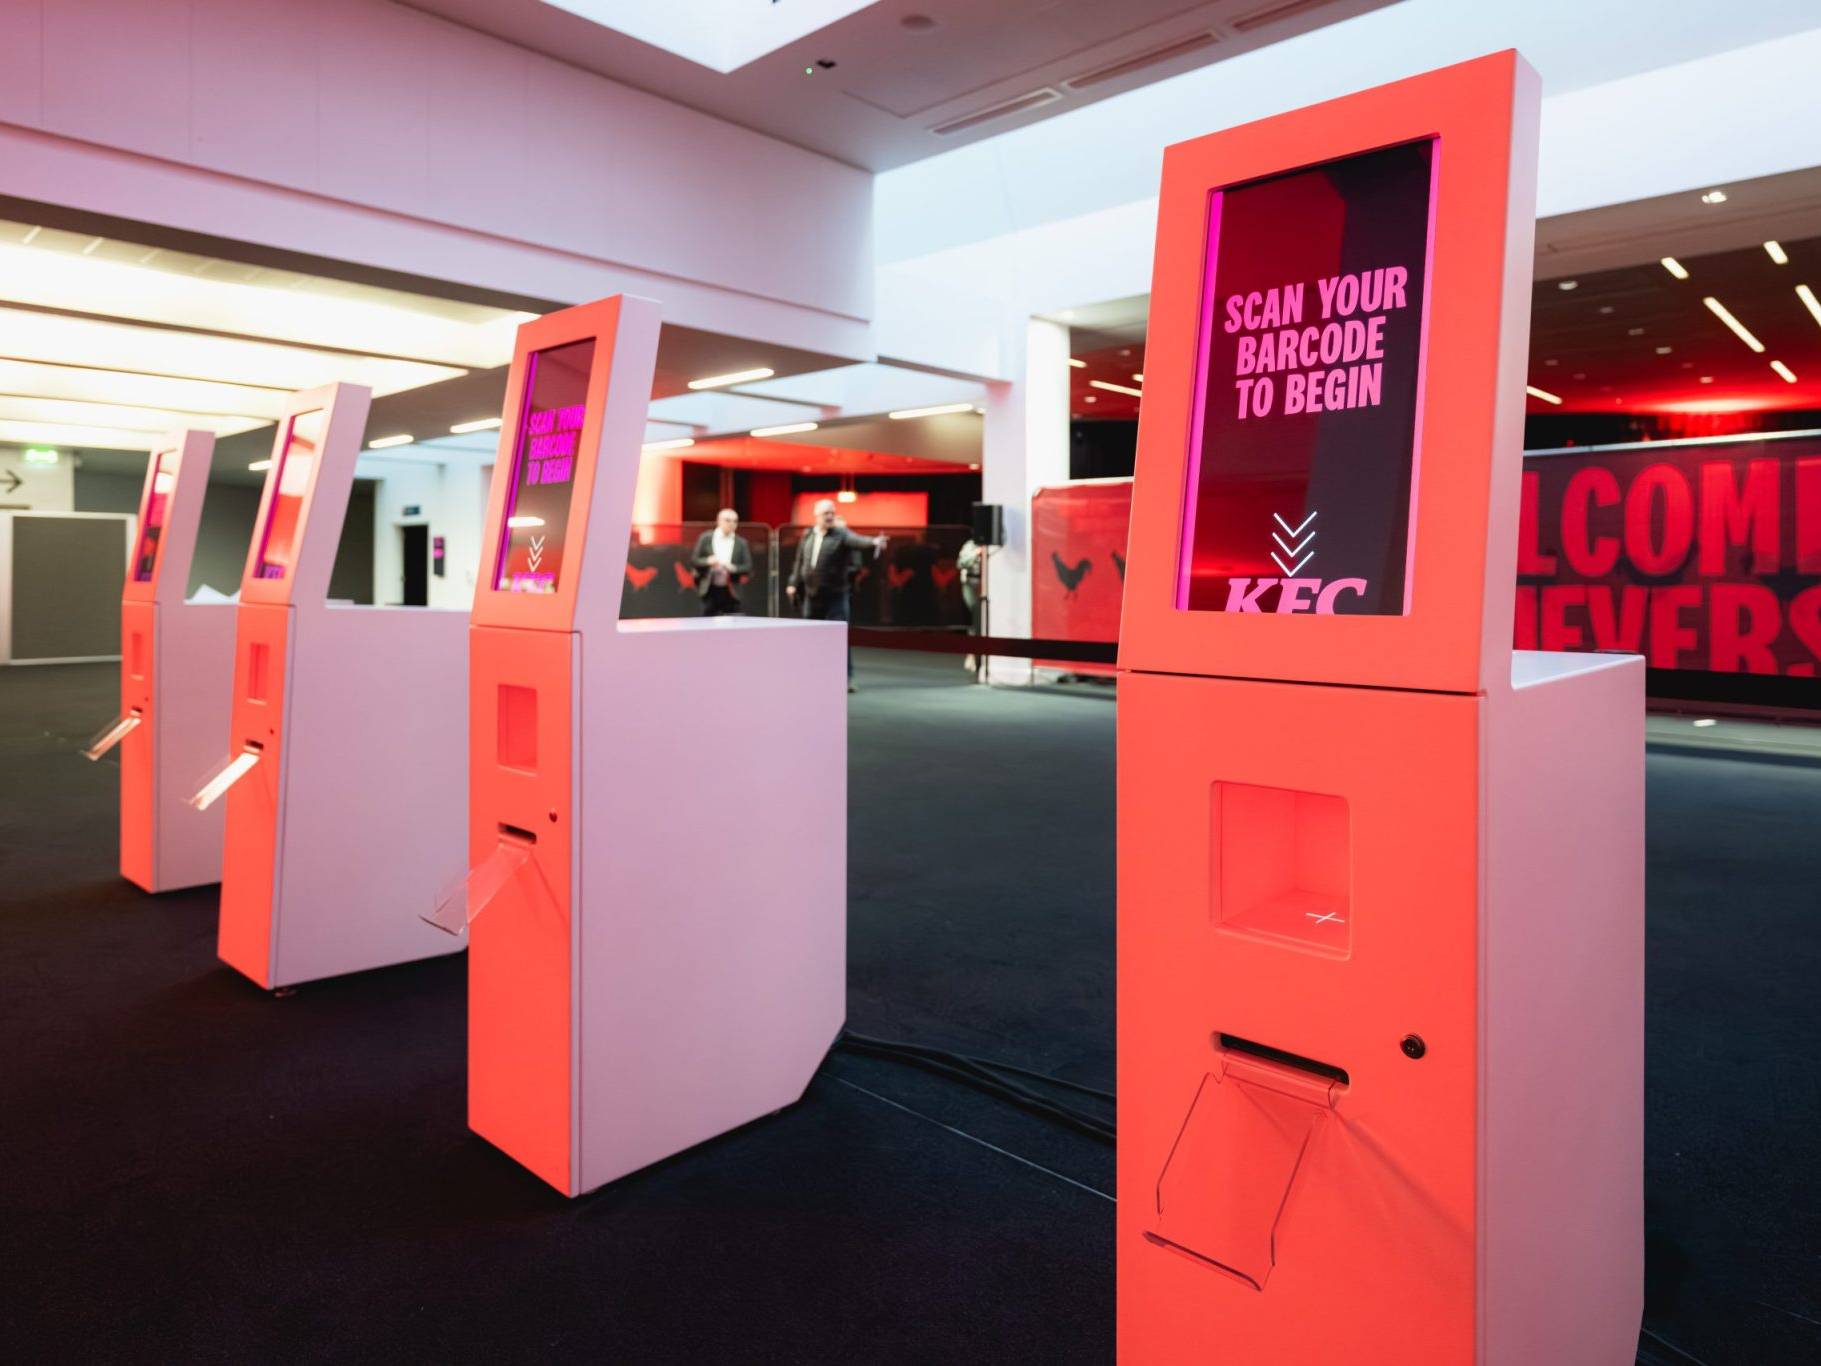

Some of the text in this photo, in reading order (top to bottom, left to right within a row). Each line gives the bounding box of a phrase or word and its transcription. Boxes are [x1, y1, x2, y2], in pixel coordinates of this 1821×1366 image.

[1224, 265, 1407, 333] SCAN YOUR
[1235, 316, 1386, 376] BARCODE
[1235, 363, 1383, 420] TO BEGIN
[1516, 456, 1821, 577] LCOM
[1513, 582, 1821, 678] IEVERS
